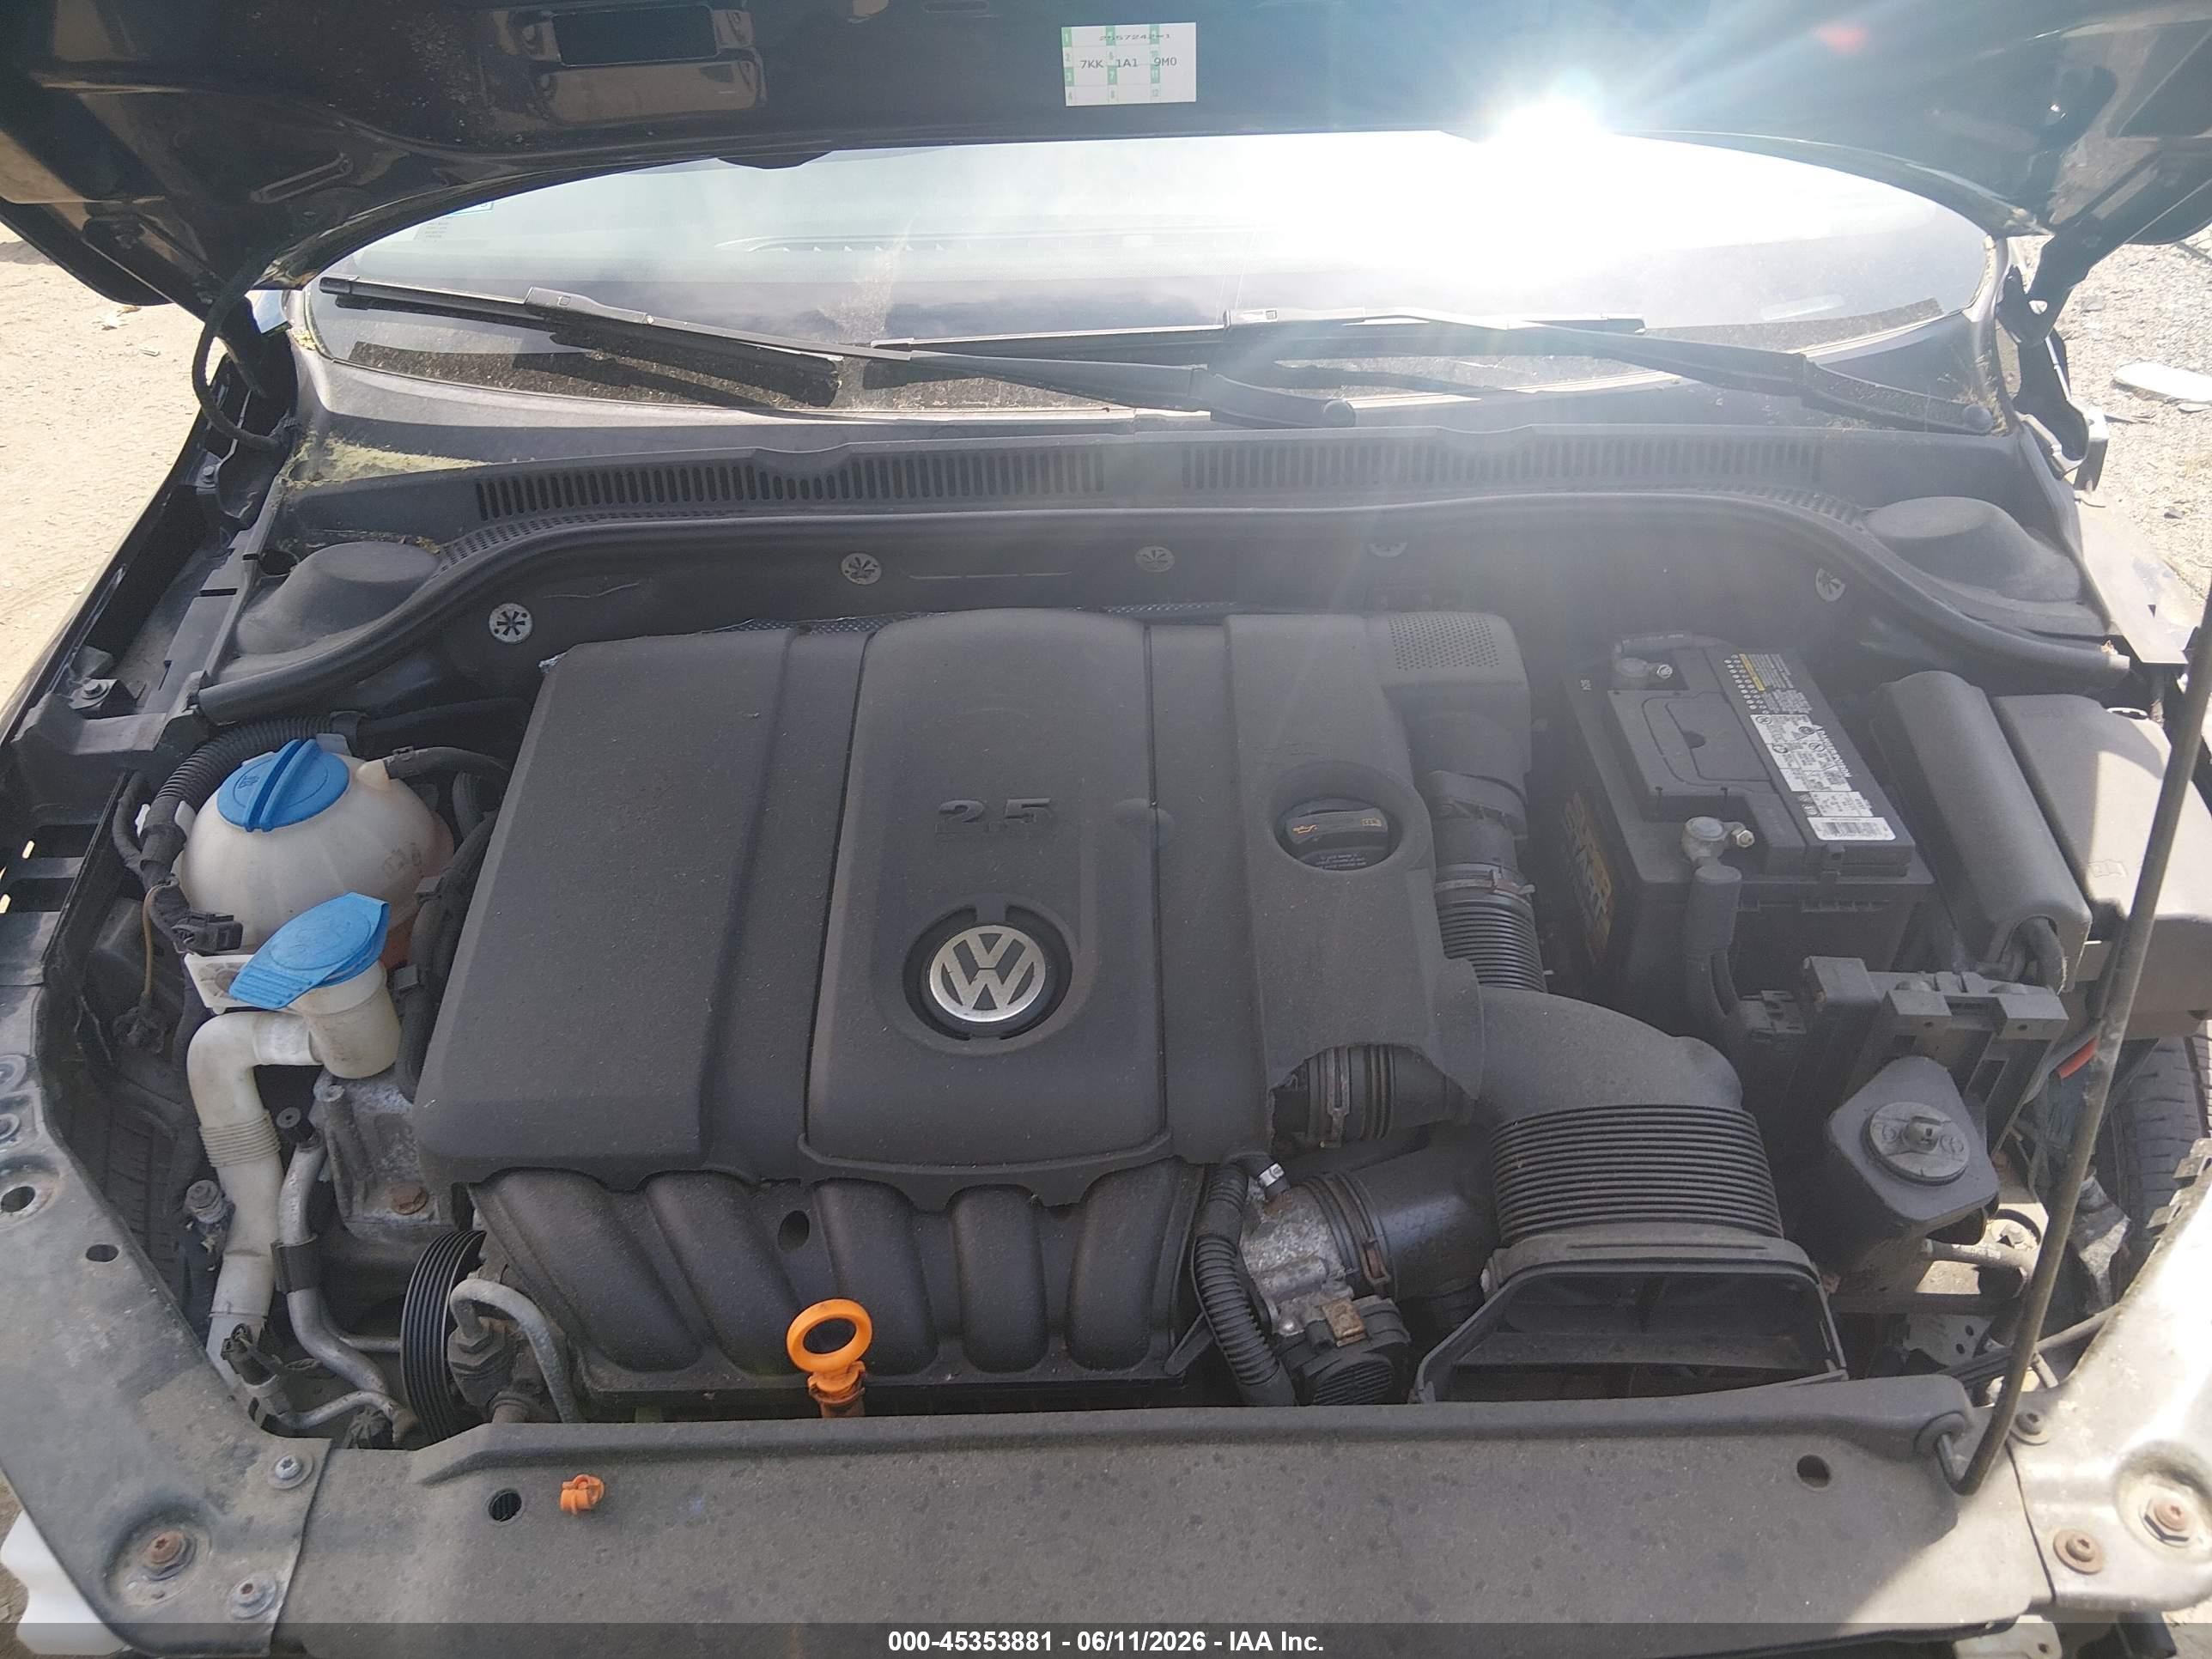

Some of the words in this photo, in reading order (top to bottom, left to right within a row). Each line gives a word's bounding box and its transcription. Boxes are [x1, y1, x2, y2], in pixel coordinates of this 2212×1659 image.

[1079, 59, 1104, 70] 7KK
[1116, 58, 1139, 69] 1A1
[929, 925, 1046, 1022] VW
